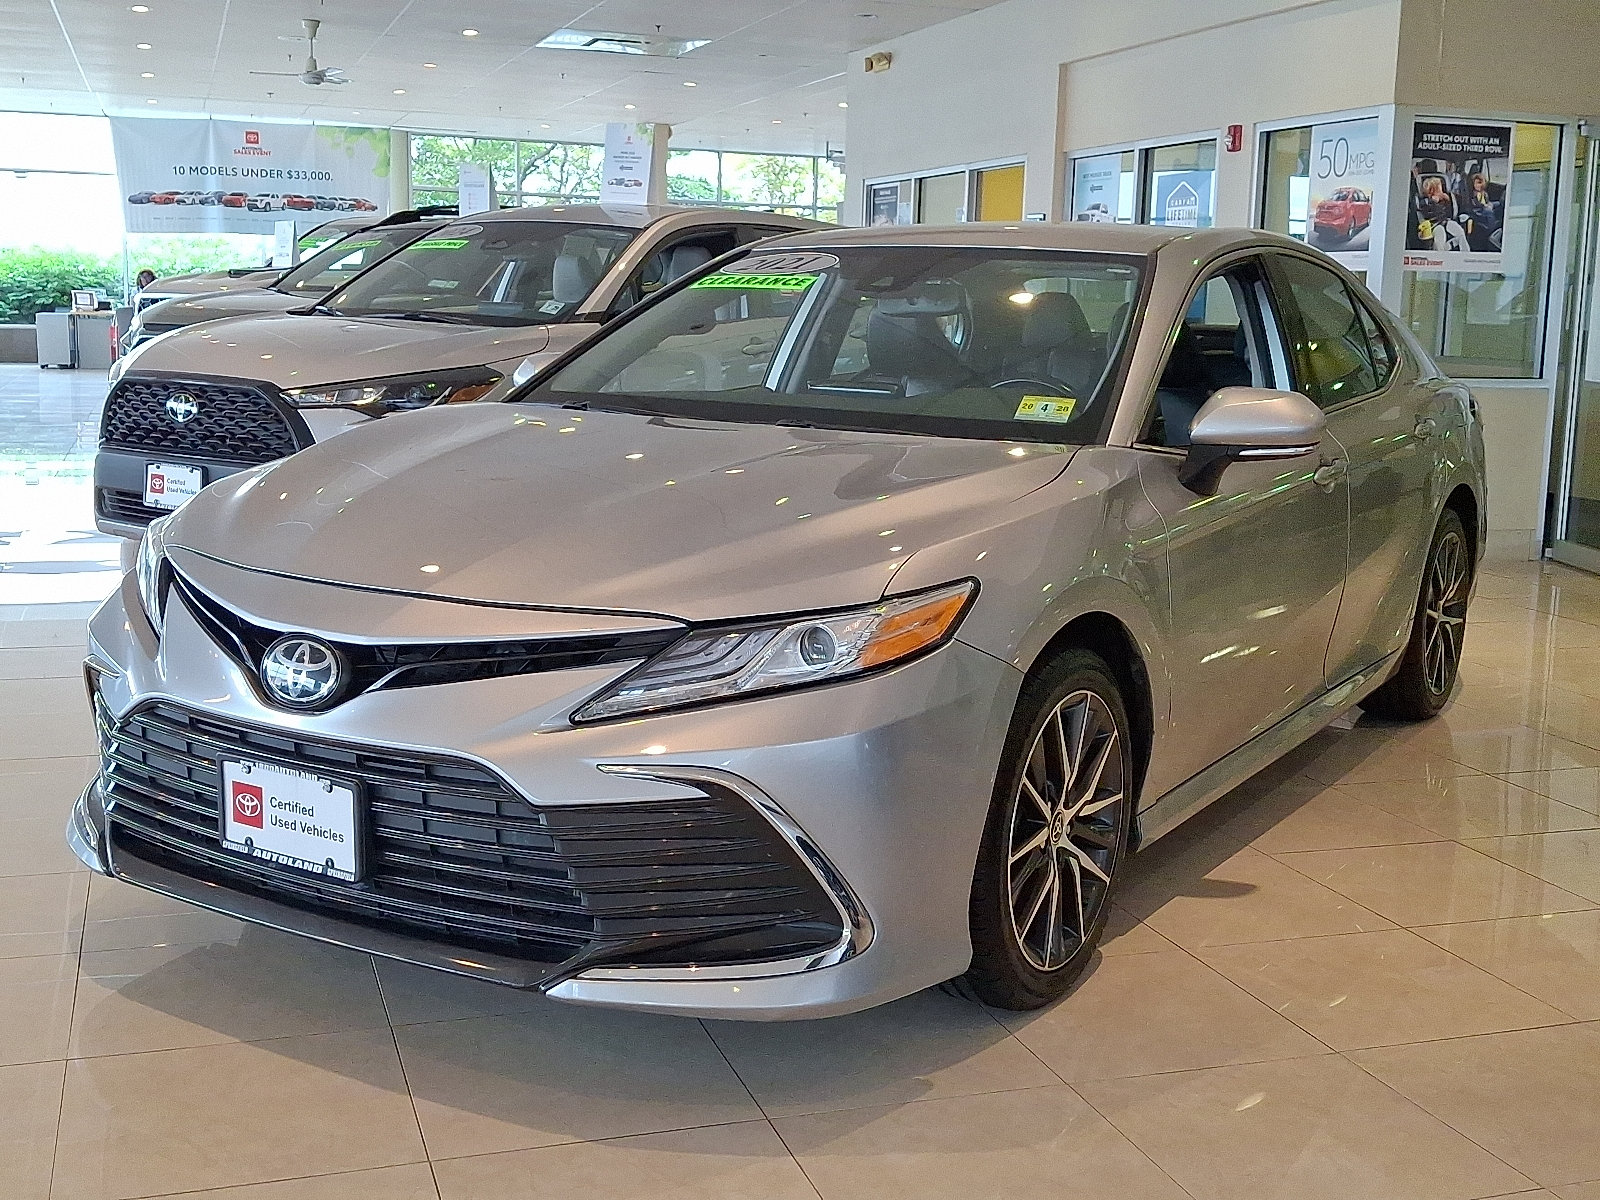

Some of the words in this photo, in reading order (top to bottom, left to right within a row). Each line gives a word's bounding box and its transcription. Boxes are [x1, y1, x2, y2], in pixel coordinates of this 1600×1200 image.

[1418, 142, 1462, 151] ADULT-SIZED
[1423, 134, 1453, 143] STRETCH
[1453, 135, 1469, 143] OUT
[1470, 137, 1488, 145] WITH
[1317, 137, 1349, 179] 50
[1348, 151, 1375, 170] MPG
[172, 165, 185, 175] 10
[189, 166, 238, 177] MODELS
[241, 168, 283, 179] UNDER
[287, 169, 333, 182] $33,000.
[697, 275, 812, 287] CLEARANCE
[1041, 403, 1049, 412] 4
[270, 796, 314, 817] Certified
[270, 813, 297, 832] Used
[299, 820, 345, 843] Vehicles
[252, 847, 323, 874] AUTOLAND
